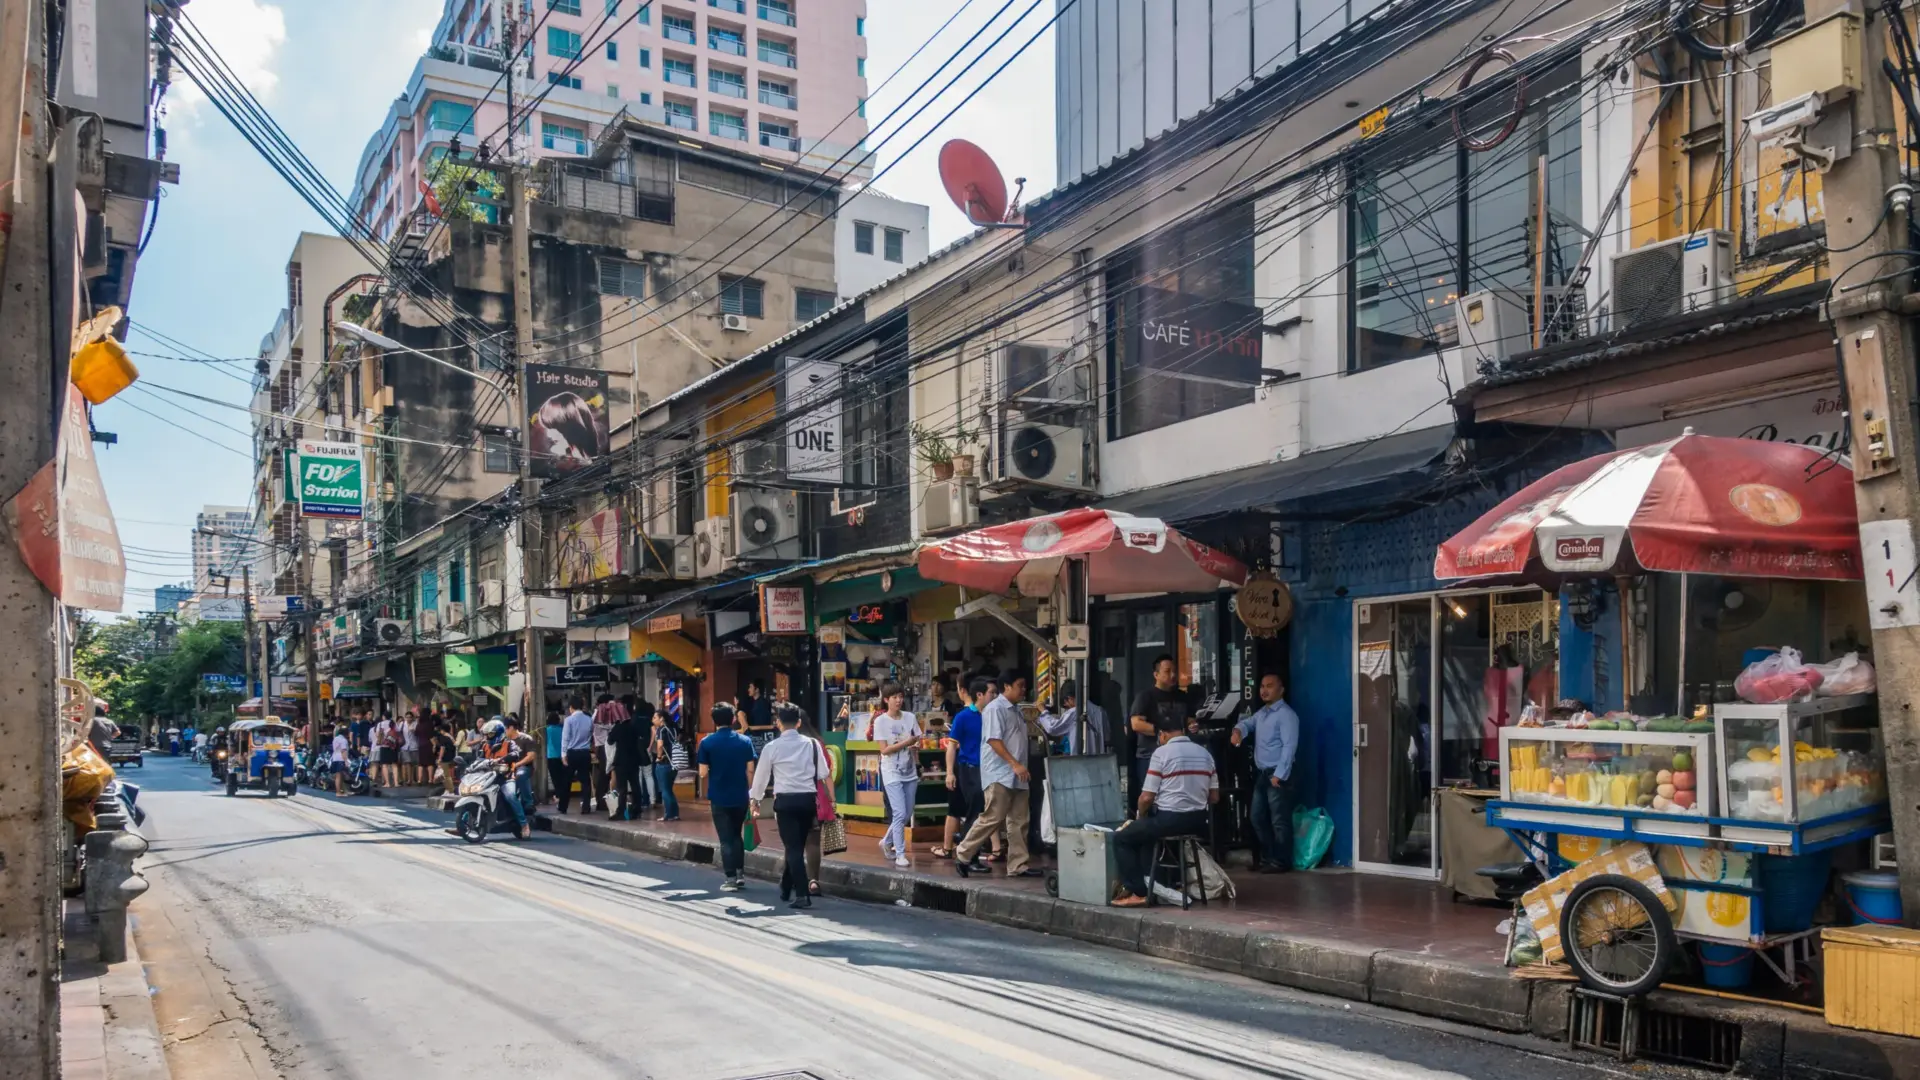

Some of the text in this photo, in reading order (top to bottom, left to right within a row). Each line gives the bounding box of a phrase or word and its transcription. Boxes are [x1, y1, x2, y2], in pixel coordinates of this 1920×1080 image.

[1142, 320, 1191, 346] CAFÉ
[536, 371, 599, 388] Hair Studio
[794, 429, 835, 453] ONE
[316, 446, 356, 456] FUJIFILM
[1558, 543, 1601, 557] Carnation
[1882, 540, 1891, 560] 1
[1886, 568, 1895, 588] 1
[859, 606, 884, 623] Coffee
[776, 620, 801, 630] Hair-cut
